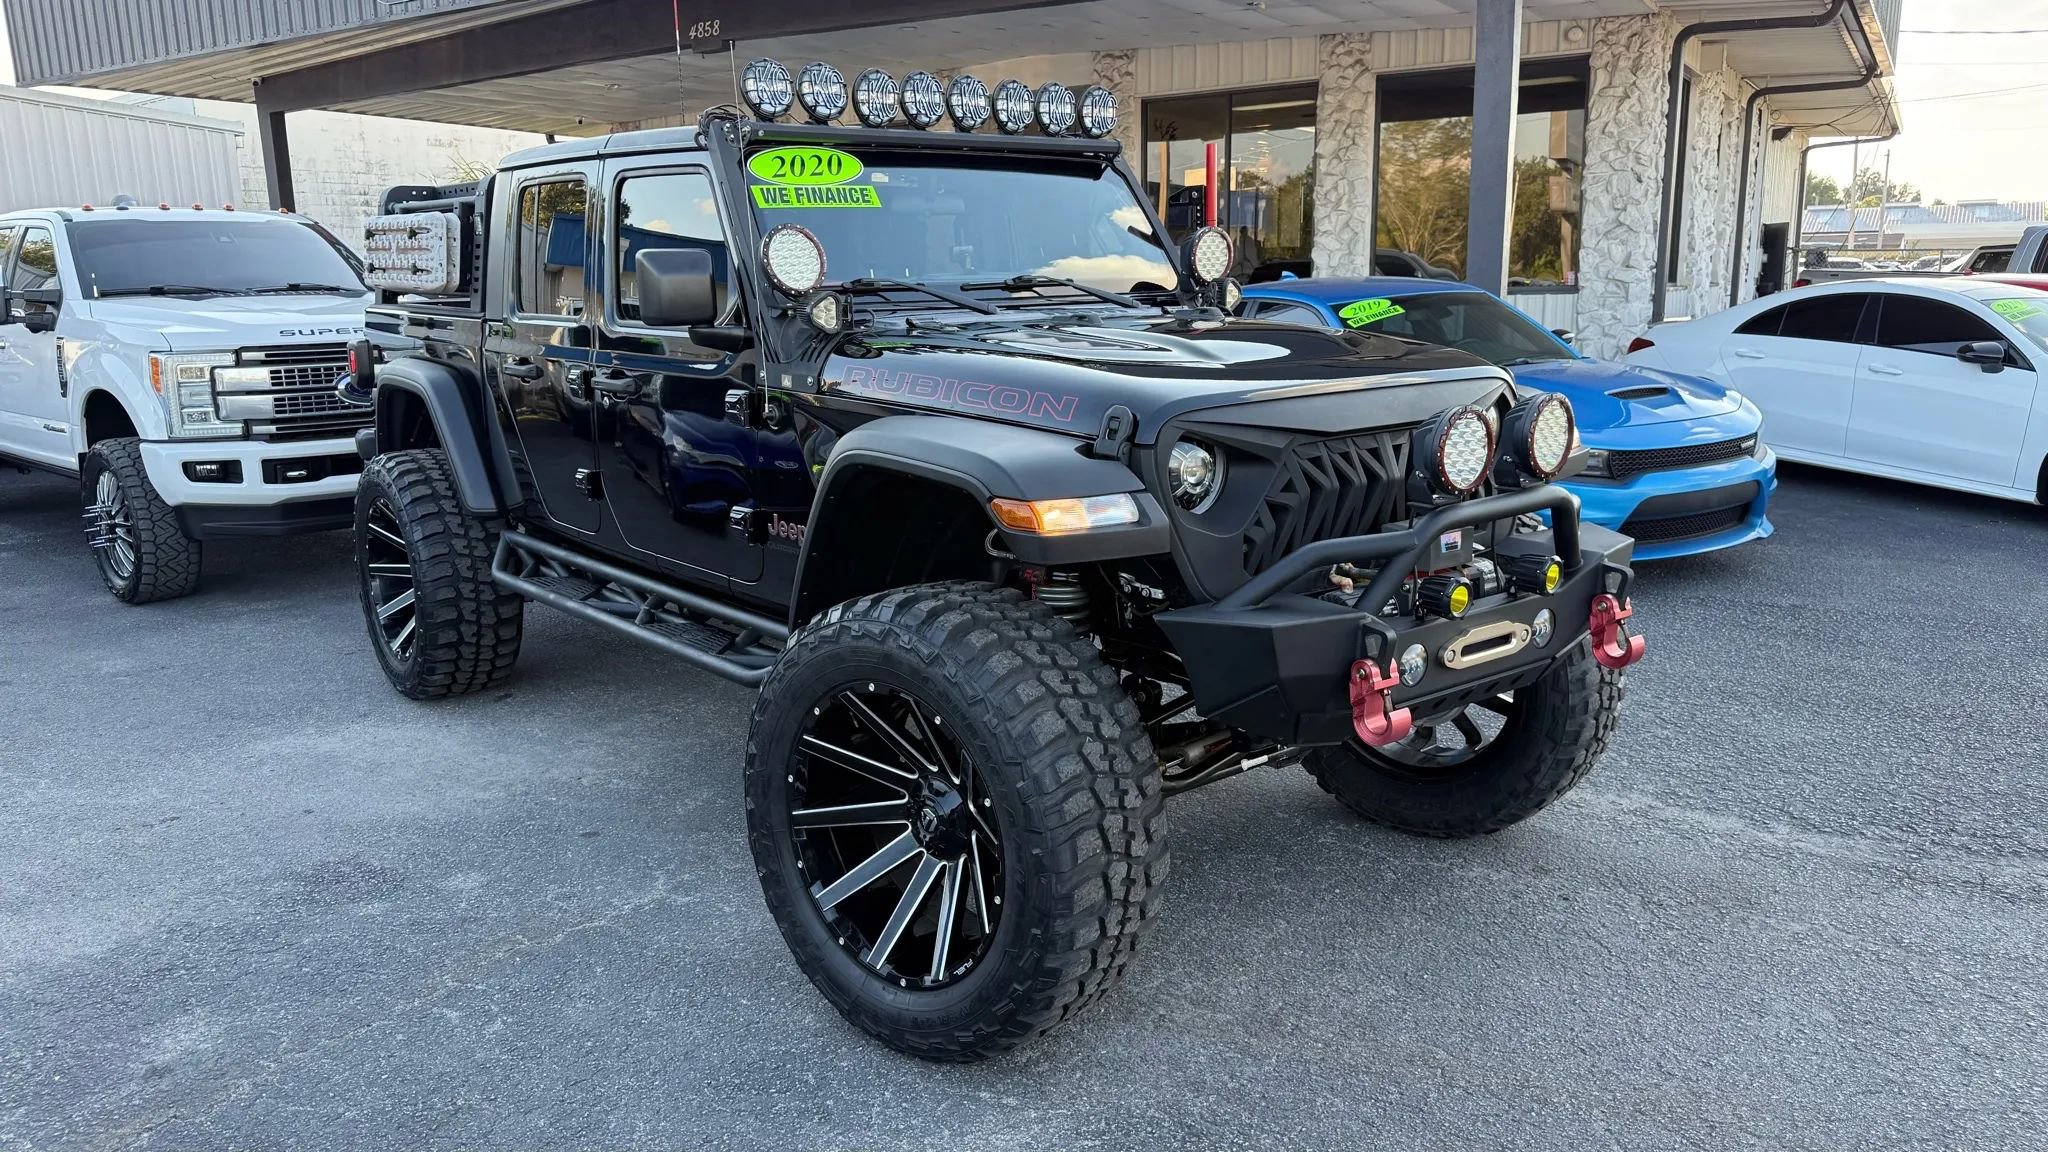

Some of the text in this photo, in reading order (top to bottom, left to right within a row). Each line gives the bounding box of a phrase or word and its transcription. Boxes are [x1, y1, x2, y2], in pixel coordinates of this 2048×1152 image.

[689, 20, 720, 39] 4858
[755, 62, 792, 106] KC
[811, 66, 846, 109] KC
[869, 75, 900, 119] KC
[914, 75, 944, 117] KC
[961, 79, 990, 121] KC
[1007, 85, 1034, 125] KC
[1050, 87, 1076, 127] KC
[1093, 91, 1118, 131] KC
[771, 153, 842, 178] 2020
[759, 187, 873, 206] WE FINANCE
[1351, 300, 1381, 316] 2019
[1351, 316, 1366, 325] WE
[842, 365, 1079, 422] RUBICON
[768, 513, 806, 547] Jeep
